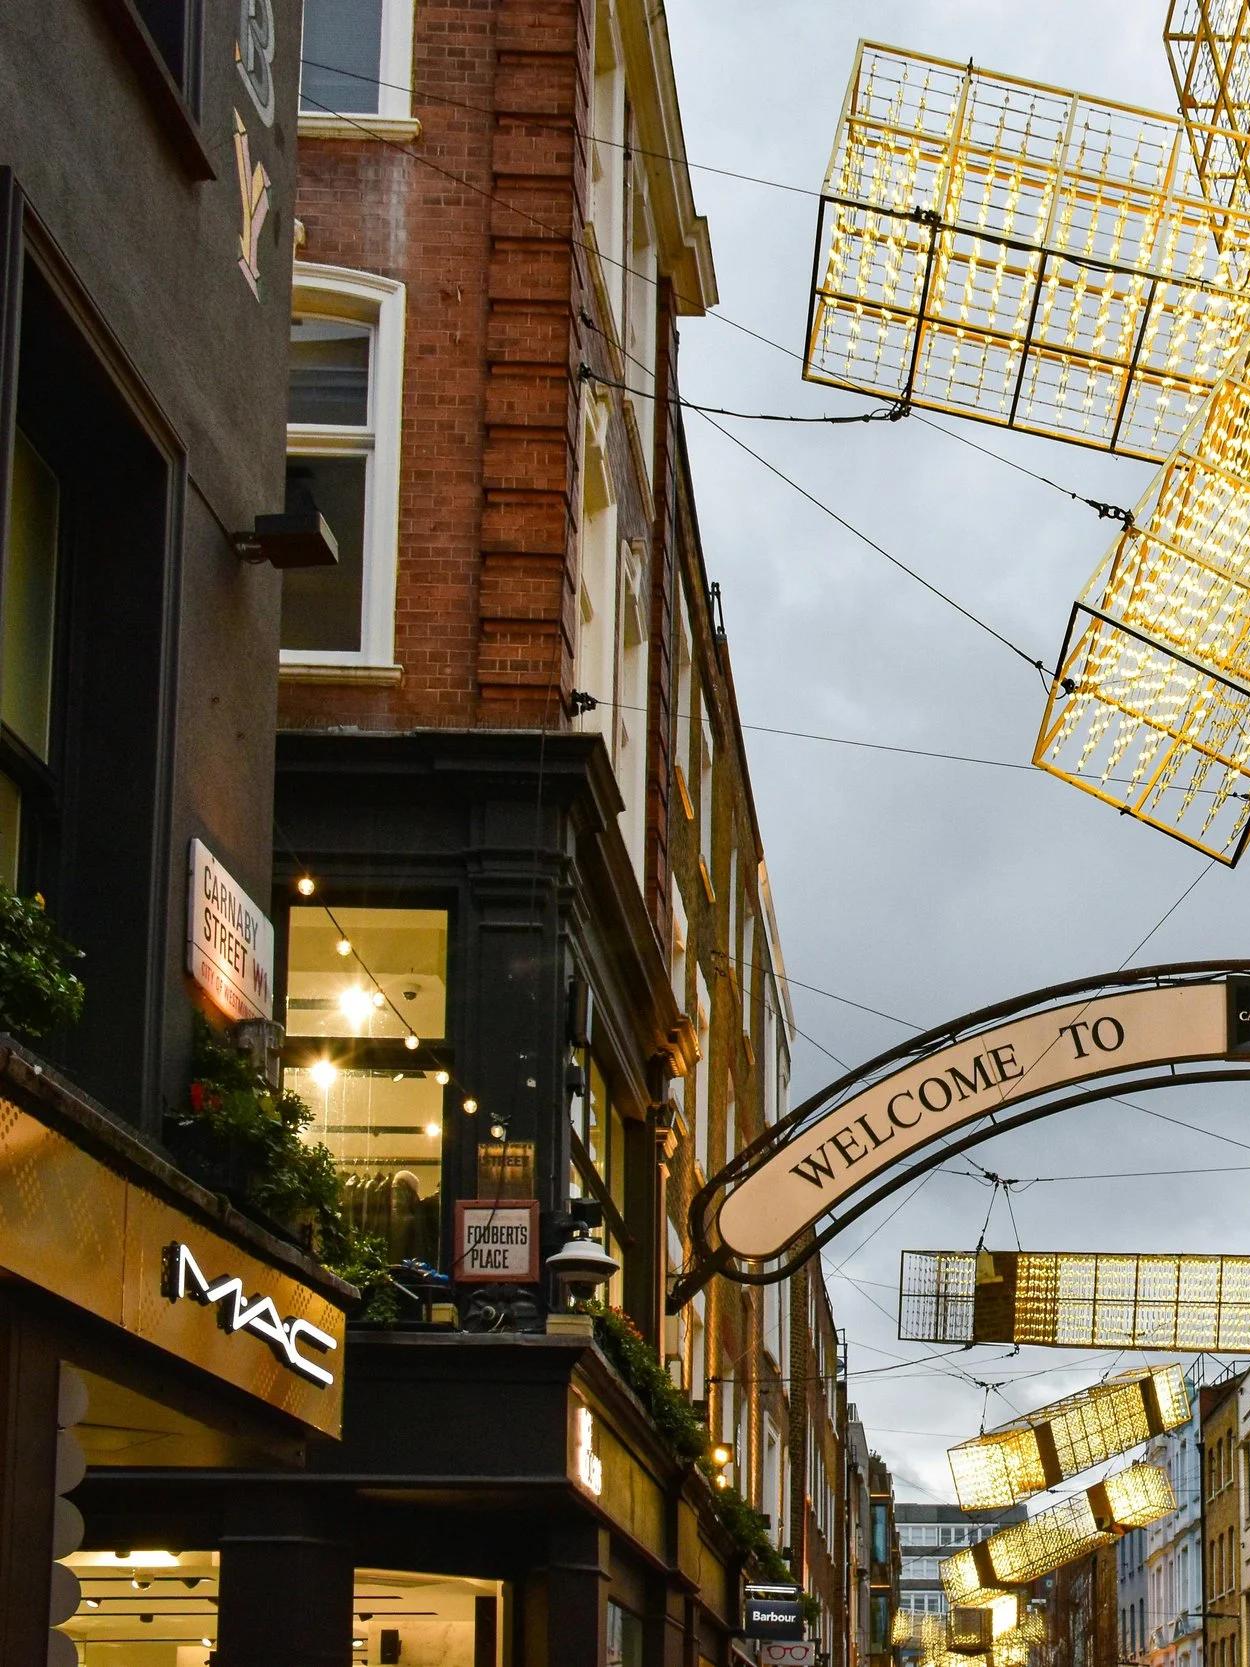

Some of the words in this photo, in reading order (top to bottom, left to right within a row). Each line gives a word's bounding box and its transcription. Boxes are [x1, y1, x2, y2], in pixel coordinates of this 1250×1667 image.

[204, 865, 258, 951] CARNABY
[204, 907, 248, 978] STREET
[252, 958, 268, 1004] W1
[201, 961, 214, 984] CITY
[216, 976, 223, 995] OF
[789, 1044, 1024, 1189] WELCOME
[1059, 1016, 1125, 1059] TO
[467, 1223, 527, 1245] FOUBERT'S
[471, 1249, 509, 1269] PLACE
[752, 1611, 797, 1622] Barbour
